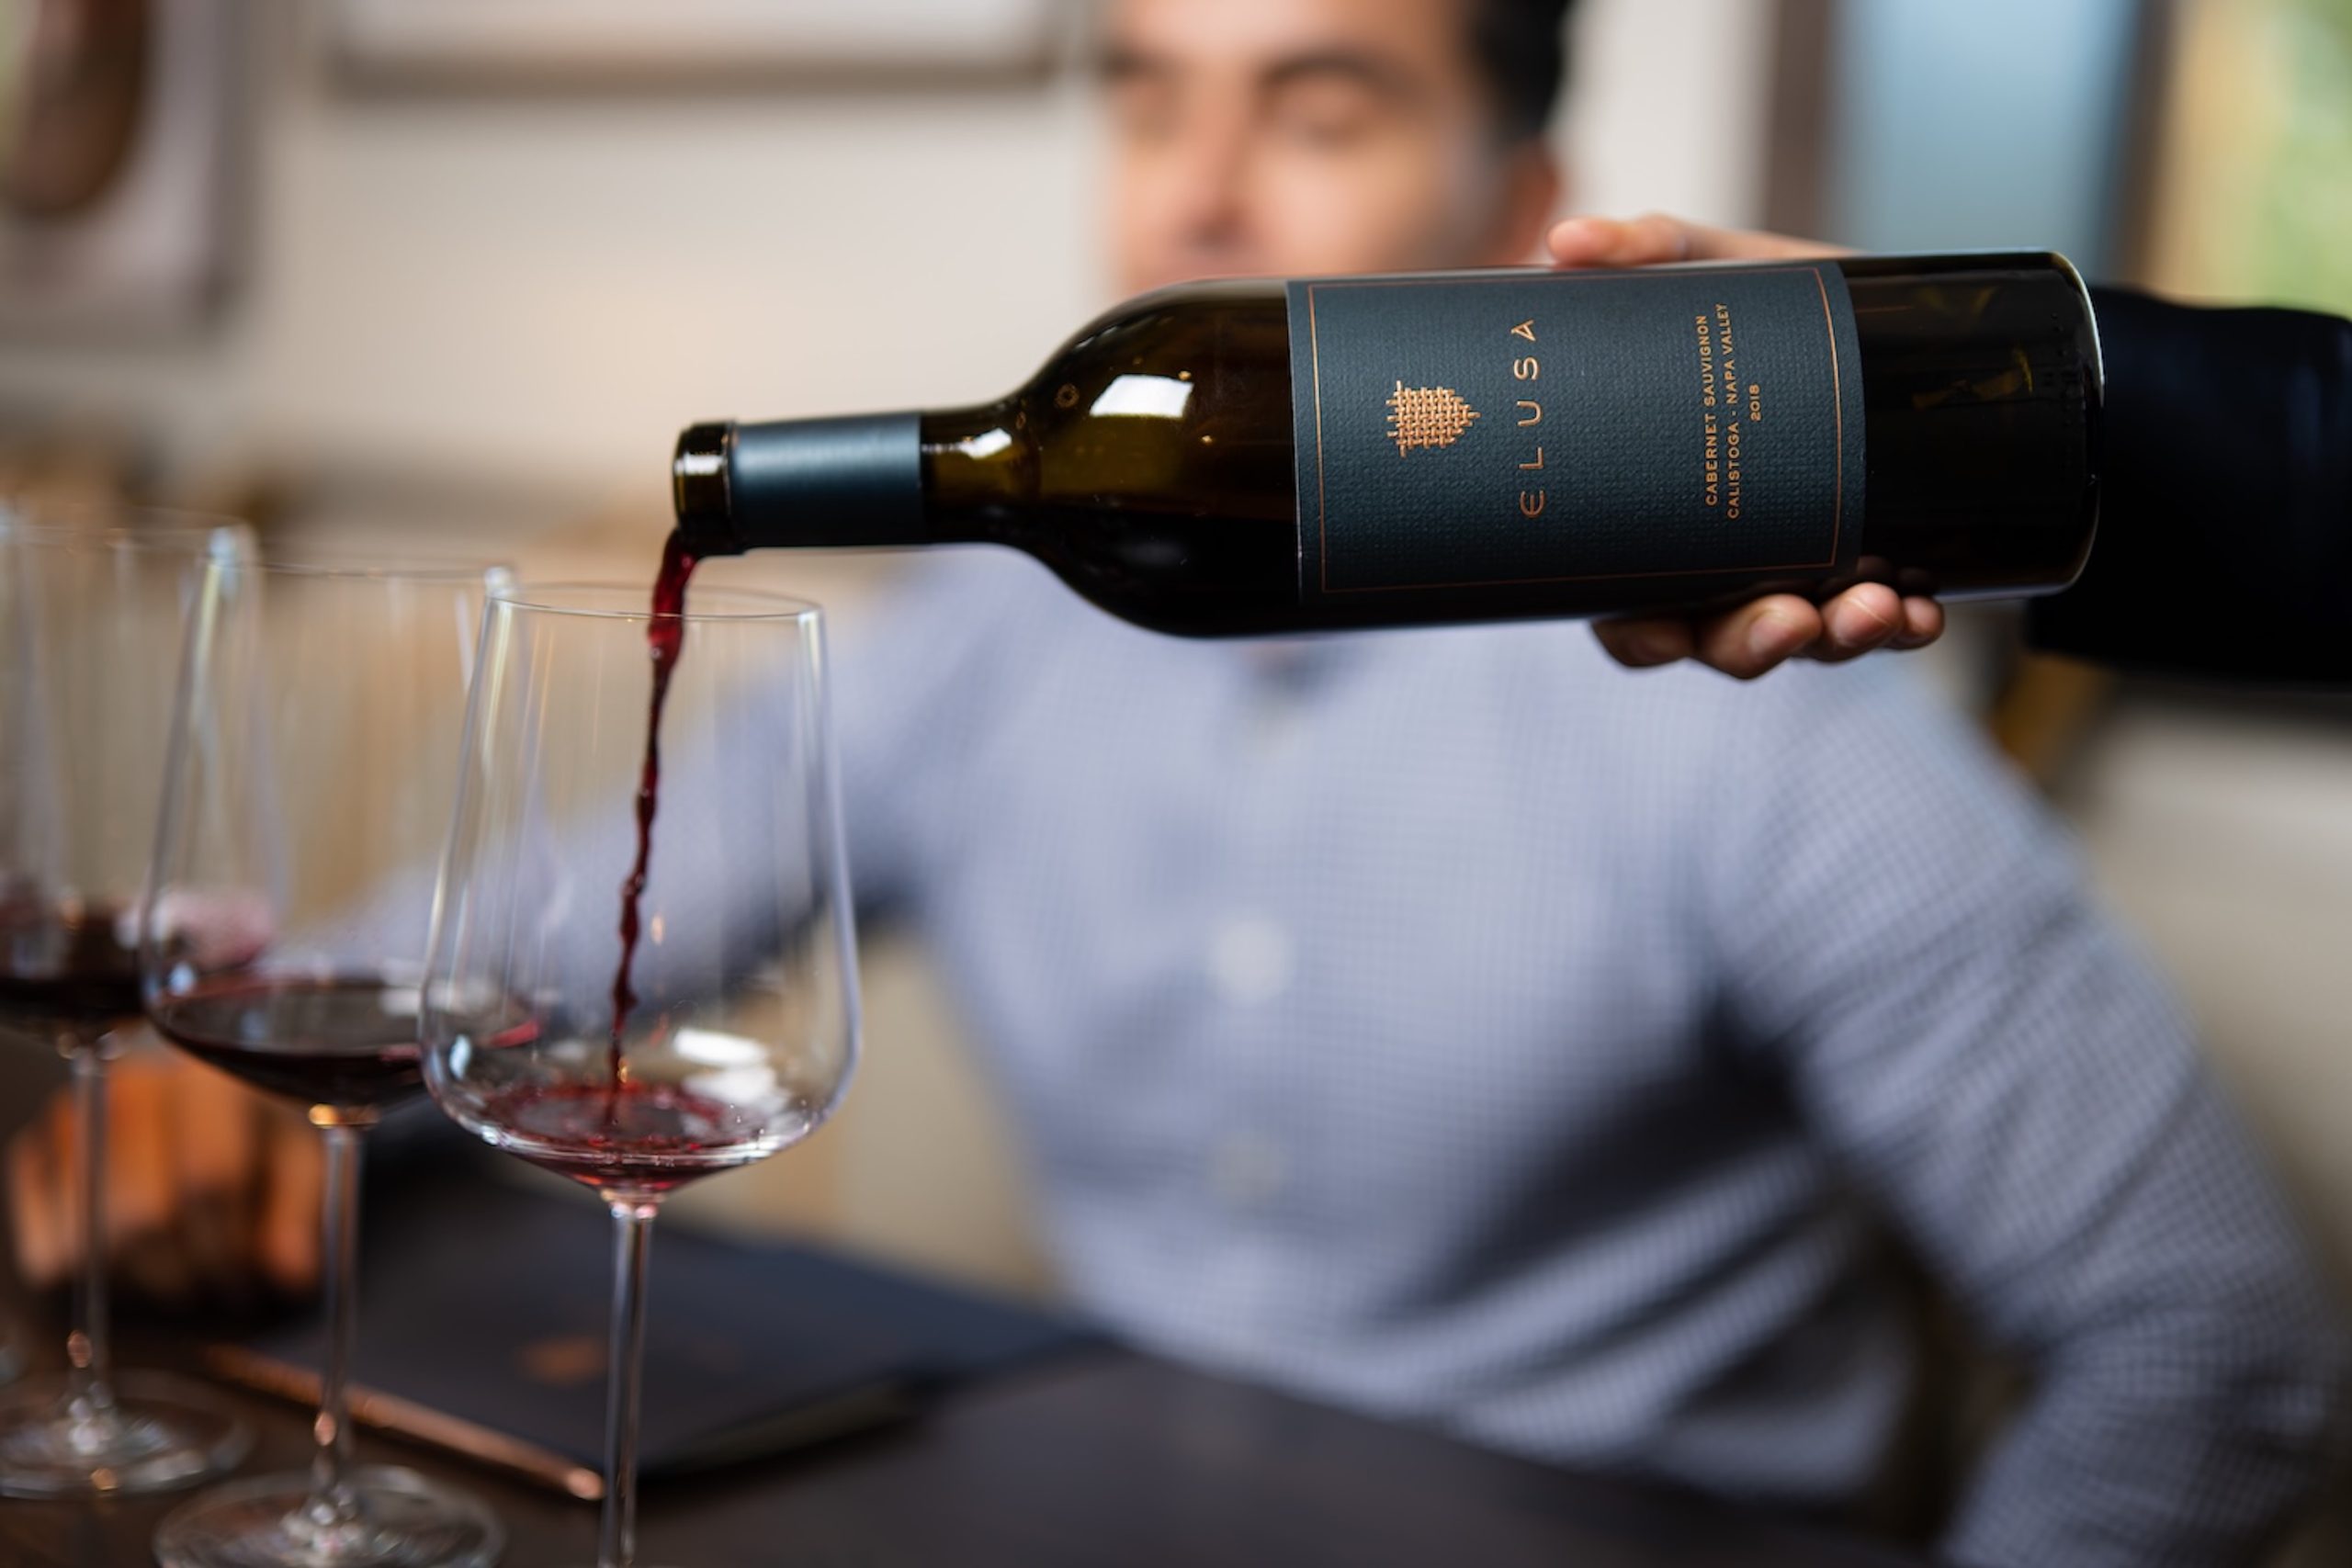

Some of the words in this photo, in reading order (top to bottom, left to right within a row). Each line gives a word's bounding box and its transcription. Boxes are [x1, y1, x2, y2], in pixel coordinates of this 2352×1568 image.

[1695, 314, 1717, 408] SAUVIGNON
[1714, 302, 1733, 355] VALLEY
[1510, 319, 1546, 520] ELUSA
[1723, 359, 1738, 406] NAPA
[1748, 383, 1762, 423] 2018
[1704, 413, 1719, 507] CABERNET
[1725, 422, 1742, 521] CALISTOGA
